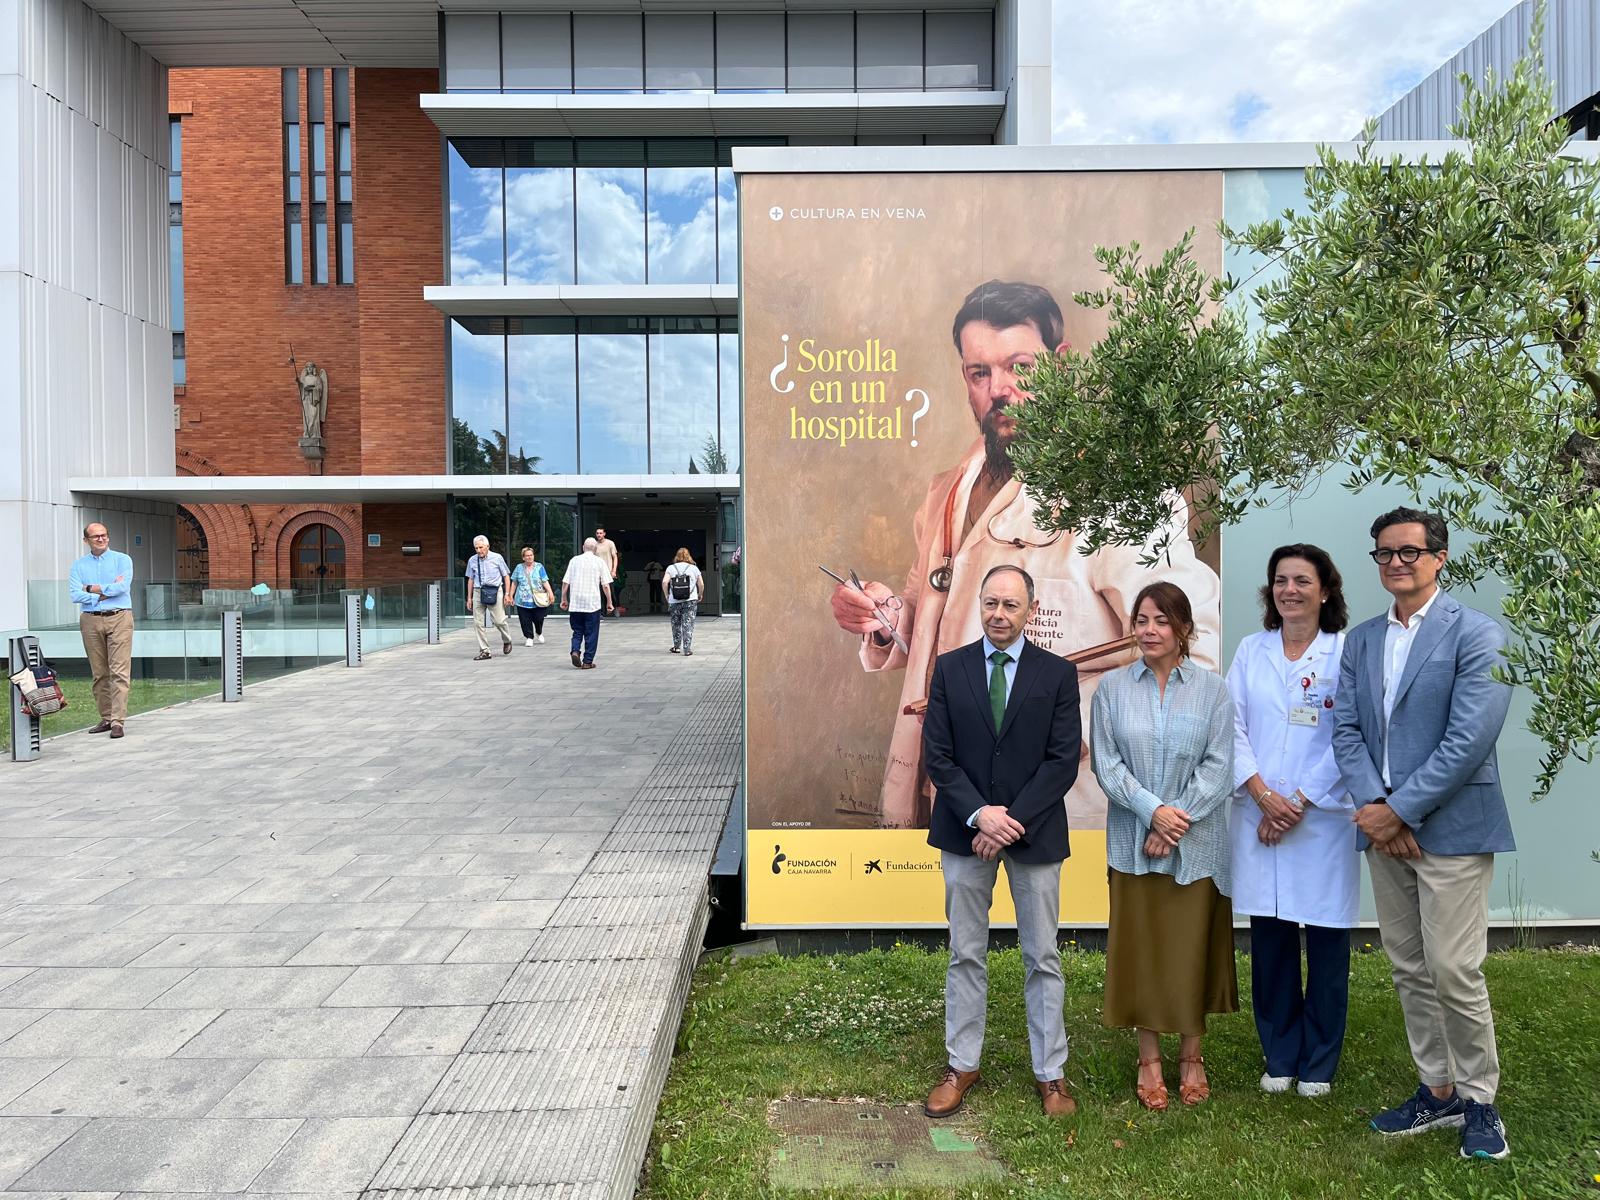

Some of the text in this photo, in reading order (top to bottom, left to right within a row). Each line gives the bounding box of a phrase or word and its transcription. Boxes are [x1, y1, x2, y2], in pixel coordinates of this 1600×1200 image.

[790, 208, 926, 219] CULTURA EN VENA
[809, 380, 886, 404] en un
[1035, 606, 1062, 616] tura
[787, 858, 837, 867] FUNDACIÓN
[886, 860, 933, 870] Fundación
